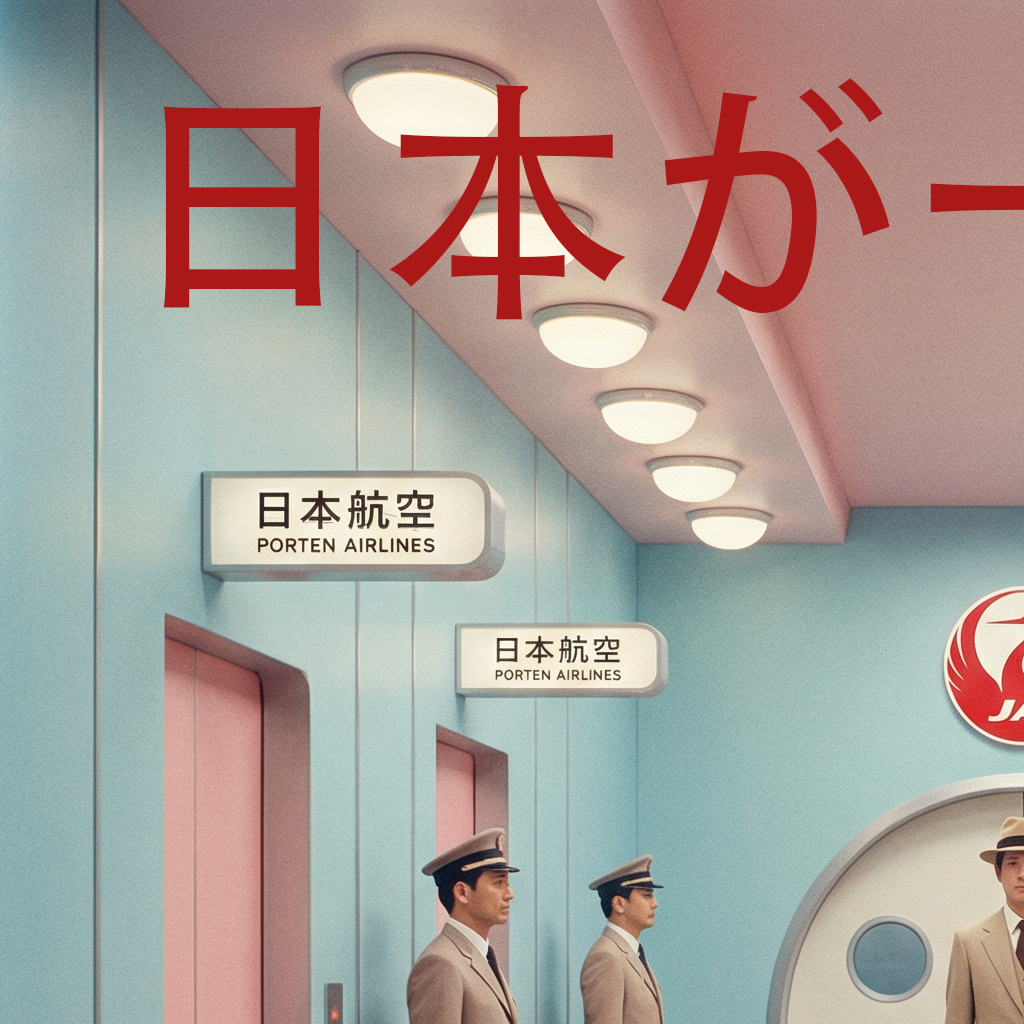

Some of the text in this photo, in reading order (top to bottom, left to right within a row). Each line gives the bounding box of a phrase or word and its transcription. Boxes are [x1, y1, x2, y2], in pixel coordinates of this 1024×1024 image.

[257, 489, 436, 531] 日本航空
[257, 537, 436, 554] PORTEN AIRLINES
[495, 635, 621, 664] 日本航空
[495, 669, 621, 681] PORTEN AIRLINES
